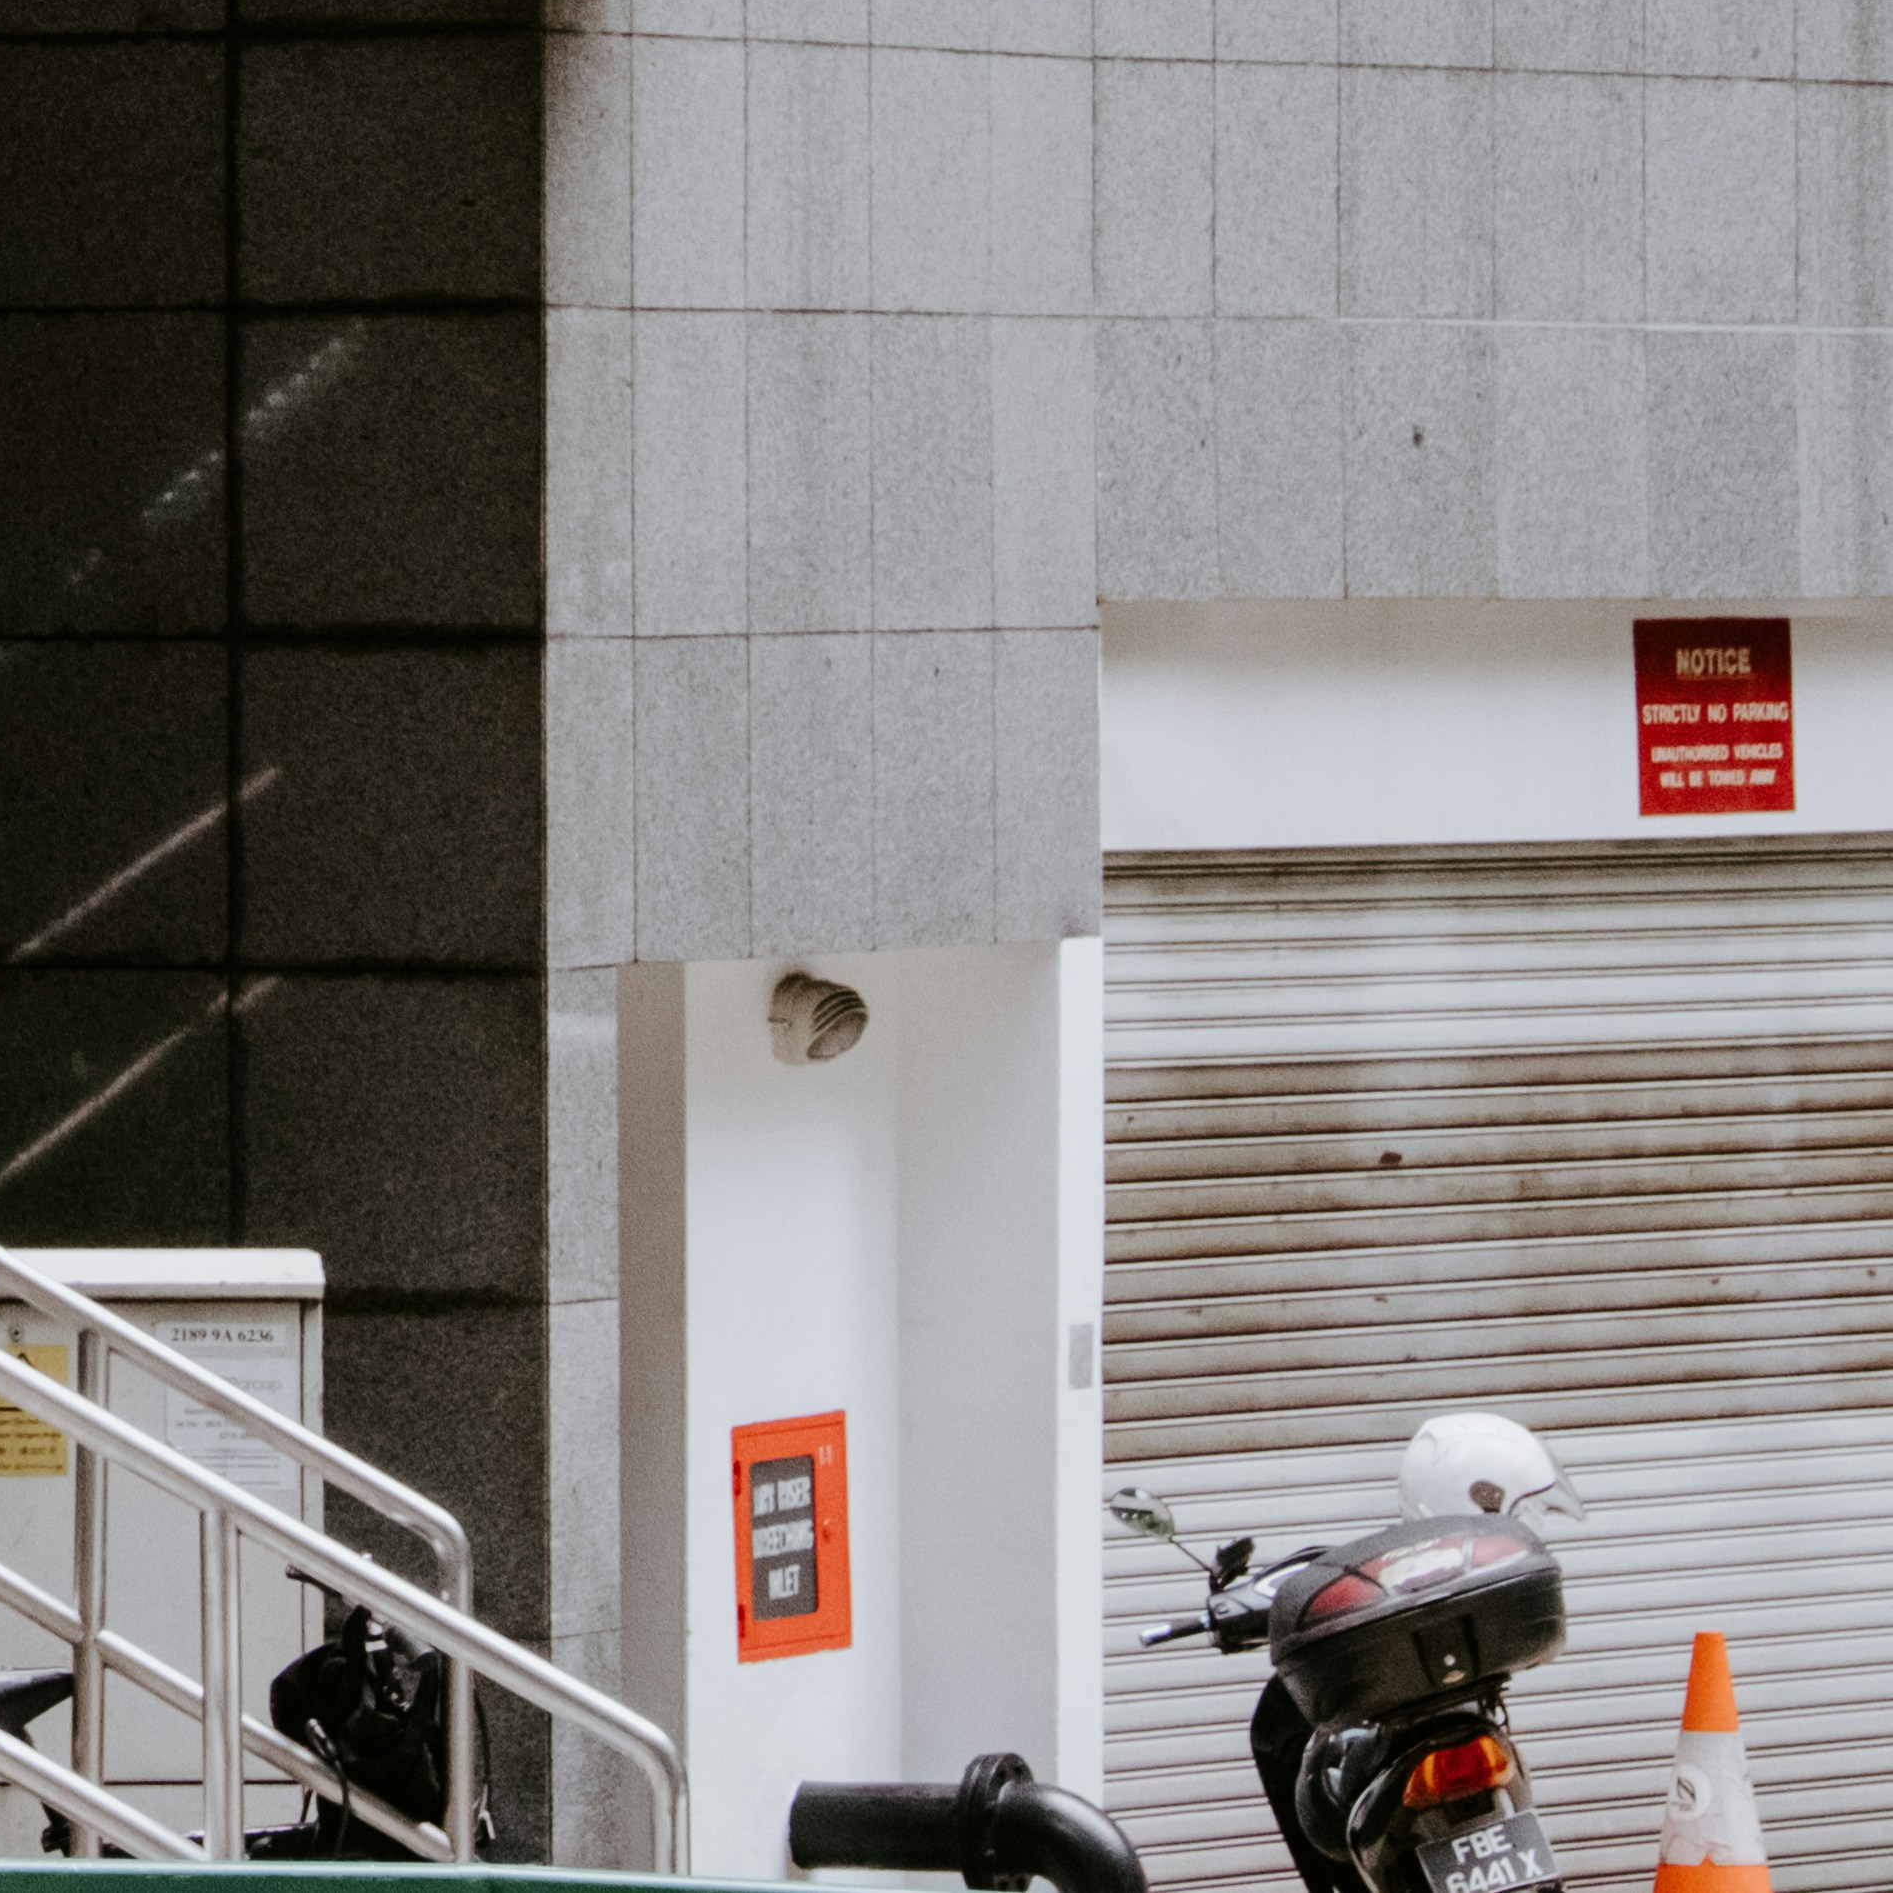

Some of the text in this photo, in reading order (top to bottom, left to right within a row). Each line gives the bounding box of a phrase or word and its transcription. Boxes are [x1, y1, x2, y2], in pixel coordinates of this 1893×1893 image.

[1676, 648, 1751, 675] NOTICE
[1642, 702, 1788, 725] STRICTLY NO PARKING
[171, 1328, 207, 1342] 2189
[1451, 1824, 1513, 1864] FBE
[1445, 1848, 1544, 1893] 6441 X
